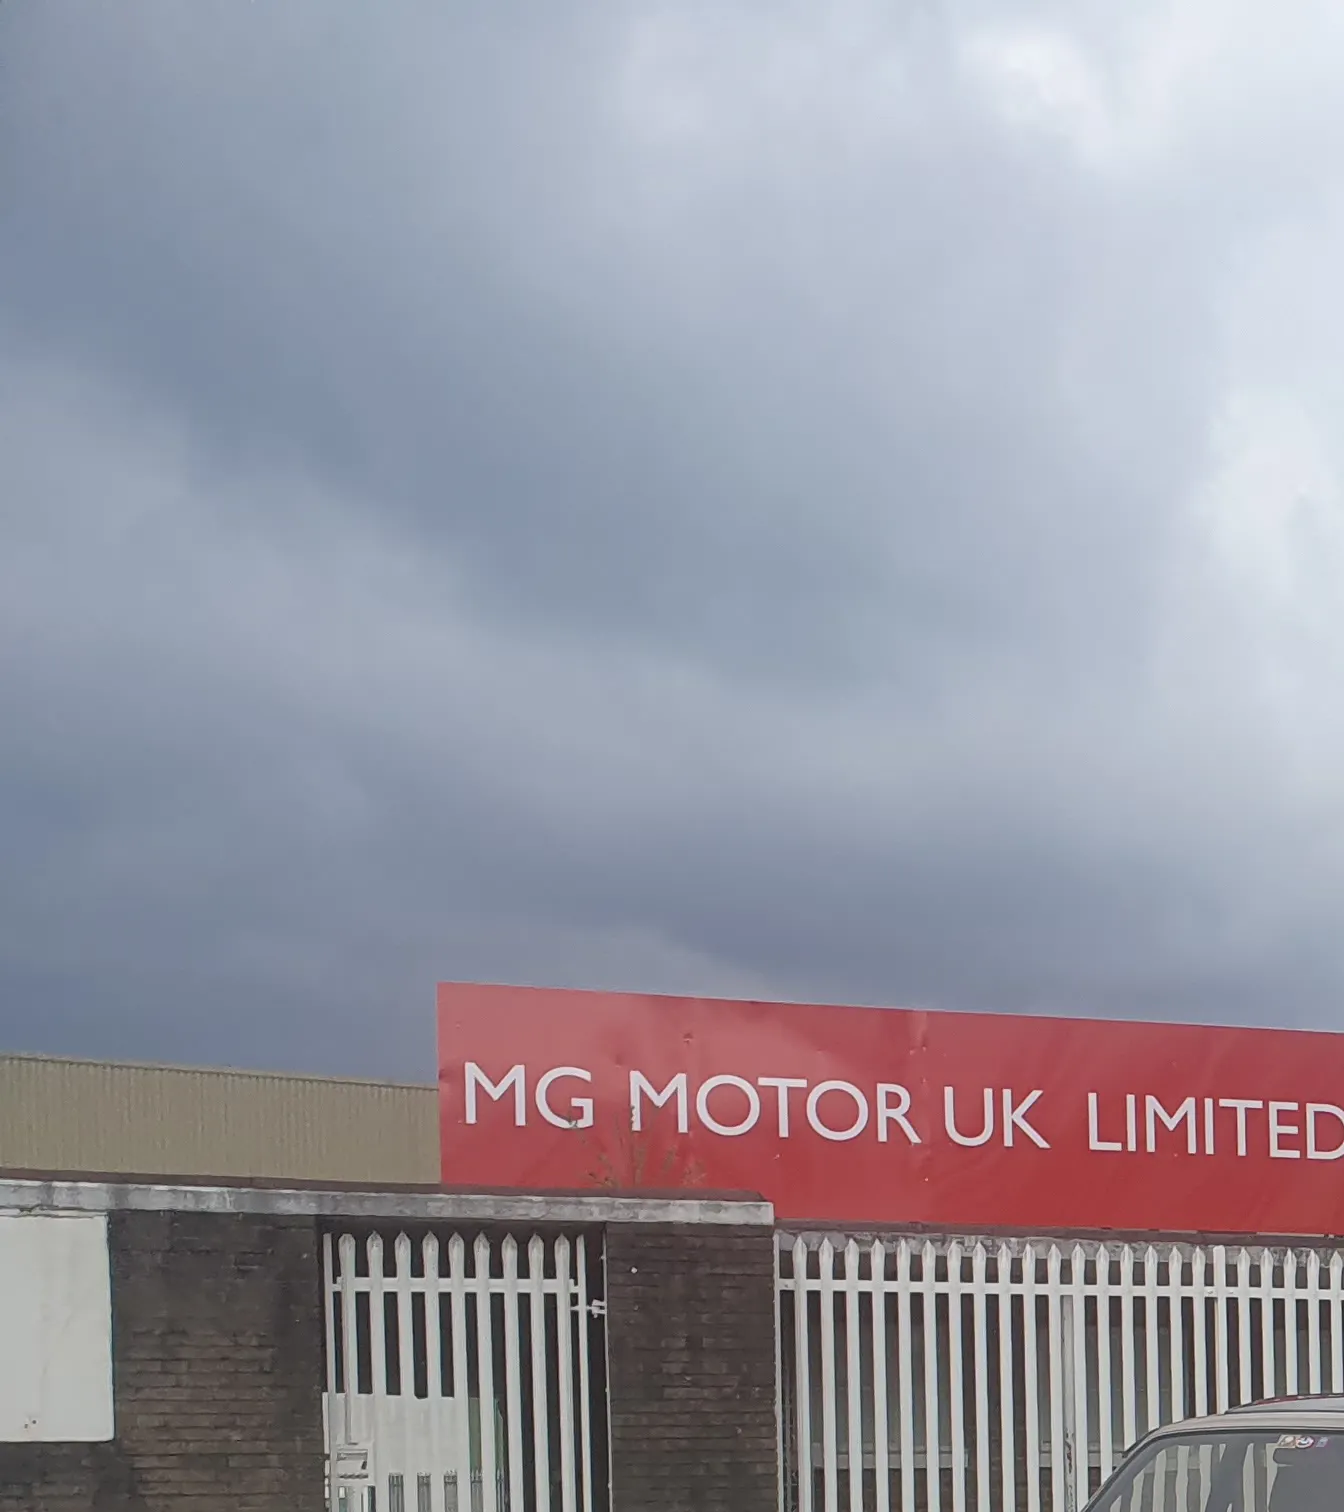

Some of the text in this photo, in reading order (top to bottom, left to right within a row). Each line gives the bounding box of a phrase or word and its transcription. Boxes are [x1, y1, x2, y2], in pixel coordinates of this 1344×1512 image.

[463, 1061, 594, 1129] MG
[629, 1070, 922, 1144] MOTOR
[944, 1086, 1050, 1149] UK
